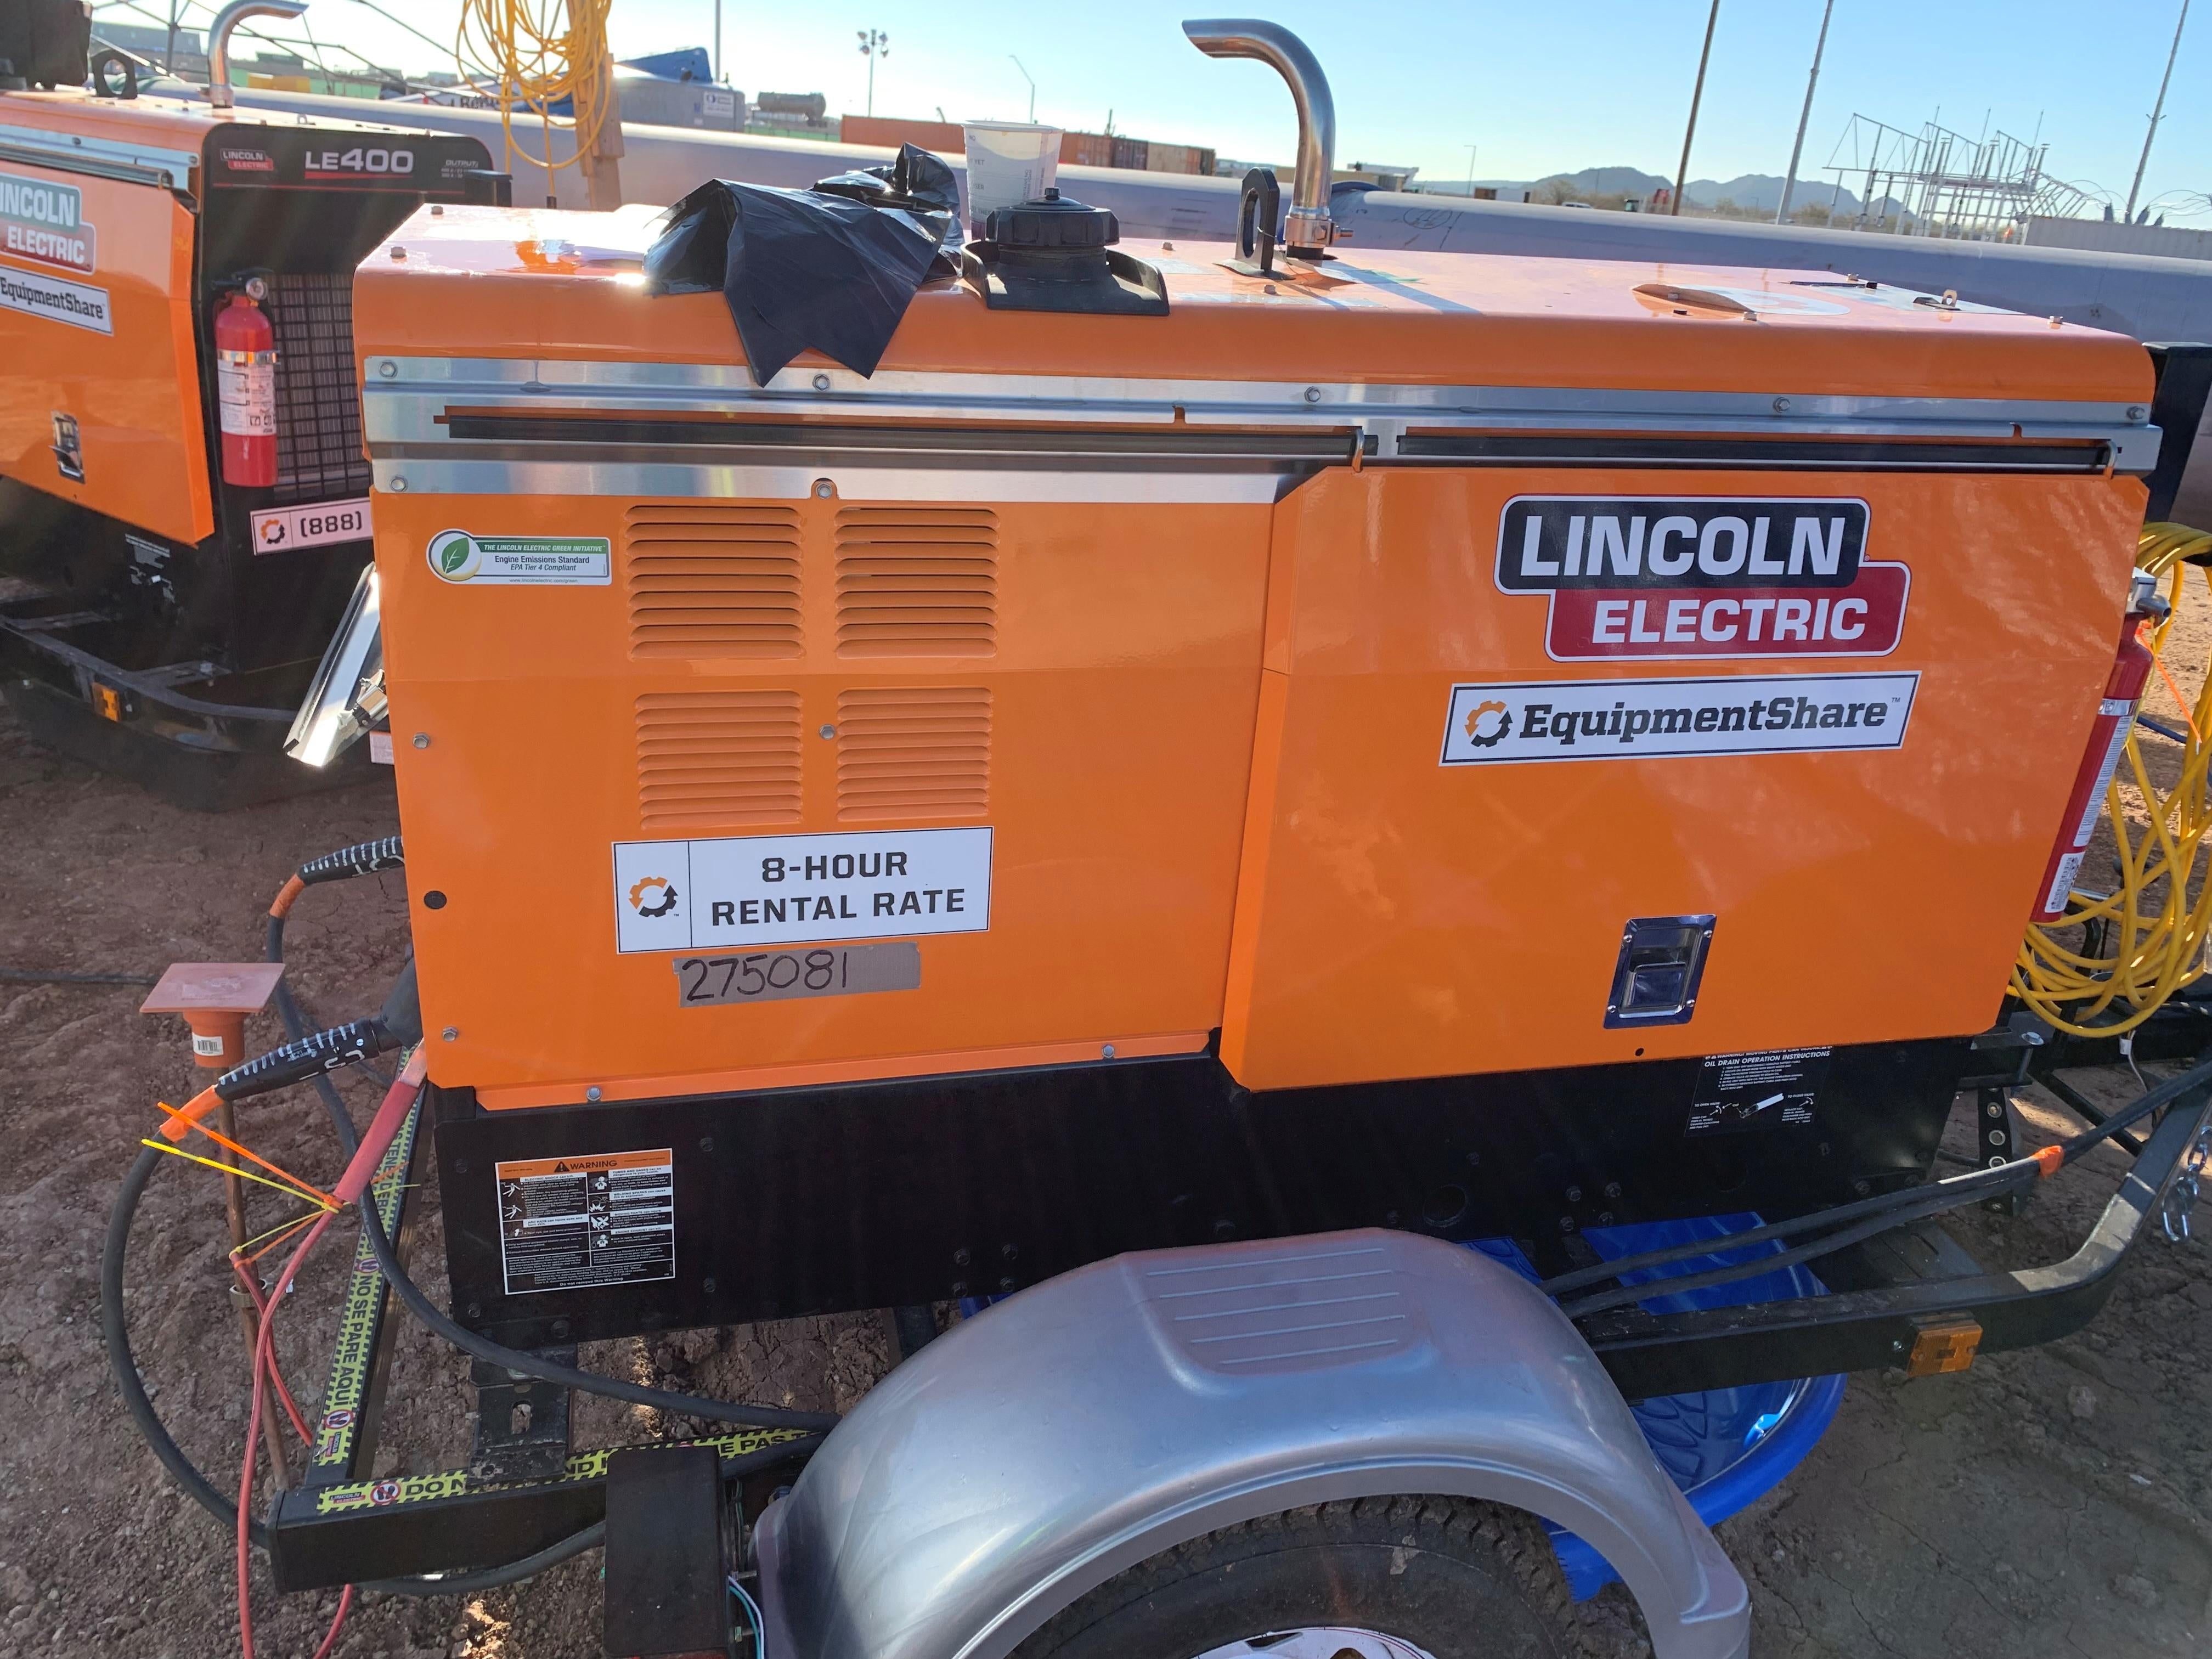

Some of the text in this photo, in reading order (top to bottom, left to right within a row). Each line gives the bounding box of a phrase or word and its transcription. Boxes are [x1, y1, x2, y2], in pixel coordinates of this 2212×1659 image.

[223, 151, 263, 160] LINCOLN
[305, 149, 414, 173] LE400
[0, 182, 76, 227] INCOLN
[7, 225, 86, 264] ELECTRIC
[1, 277, 104, 319] EquipmentShare
[300, 511, 363, 538] (888)
[1520, 515, 1846, 576] LINCOLN
[1592, 597, 1869, 644] ELECTRIC
[1520, 696, 1888, 746] EquipmentShare
[762, 851, 907, 883] 8-HOUR
[712, 888, 965, 926] RENTAL RATE
[681, 949, 848, 1002] 275081
[1741, 1055, 1780, 1064] OPERATION
[1782, 1051, 1830, 1060] INSTRUCTIONS
[570, 1160, 618, 1171] WARNING
[356, 1275, 374, 1296] NO
[351, 1299, 368, 1319] SE
[342, 1322, 364, 1363] PARE
[330, 1492, 360, 1500] LINCOLN
[405, 1481, 444, 1496] DO
